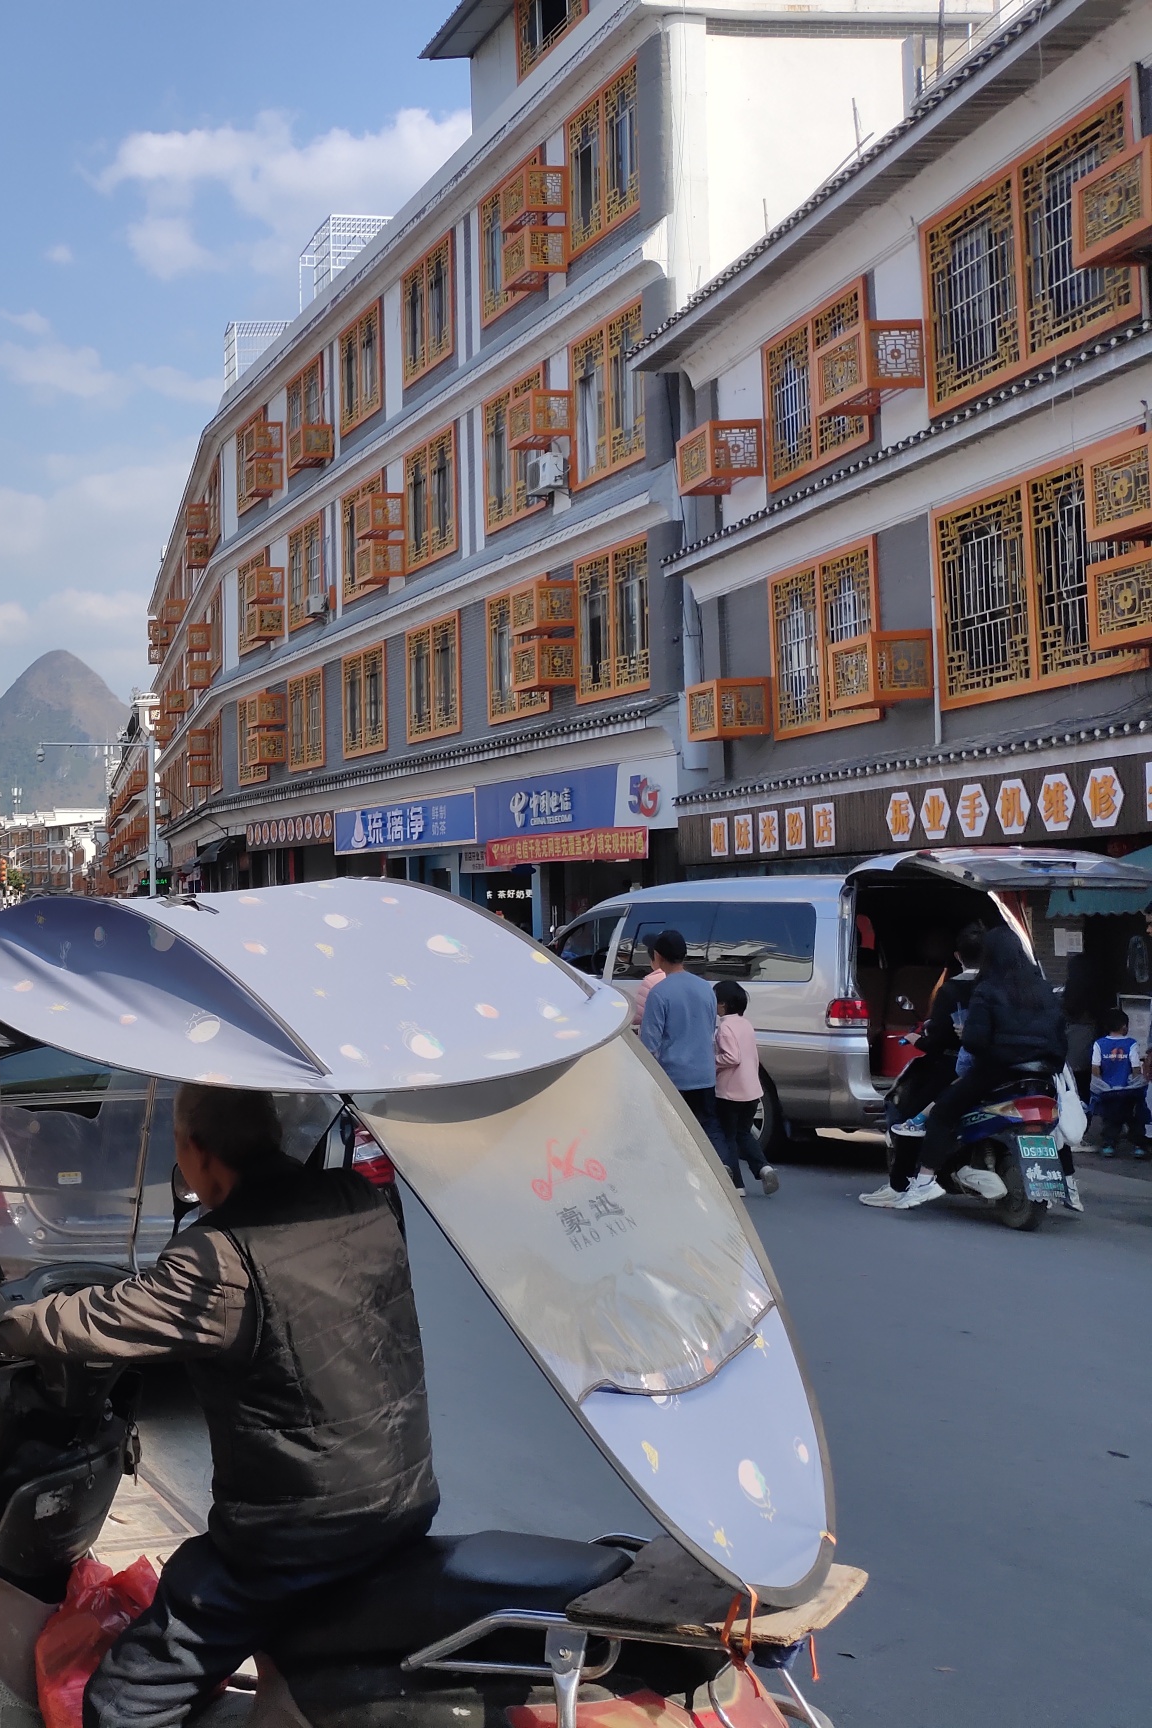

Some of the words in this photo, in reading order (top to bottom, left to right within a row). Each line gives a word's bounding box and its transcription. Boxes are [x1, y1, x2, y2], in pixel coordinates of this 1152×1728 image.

[529, 786, 572, 818] 中国电信
[627, 774, 662, 818] 5G
[890, 774, 1118, 836] 振业手机维修
[367, 806, 425, 844] 琉璃净
[431, 821, 447, 836] 奶茶
[530, 816, 546, 826] CHINA
[546, 813, 573, 825] TELECOM
[712, 806, 833, 854] 姐妹米粉店
[554, 1192, 626, 1236] 豪迅
[568, 1227, 601, 1252] HAO
[604, 1214, 638, 1237] XUN
